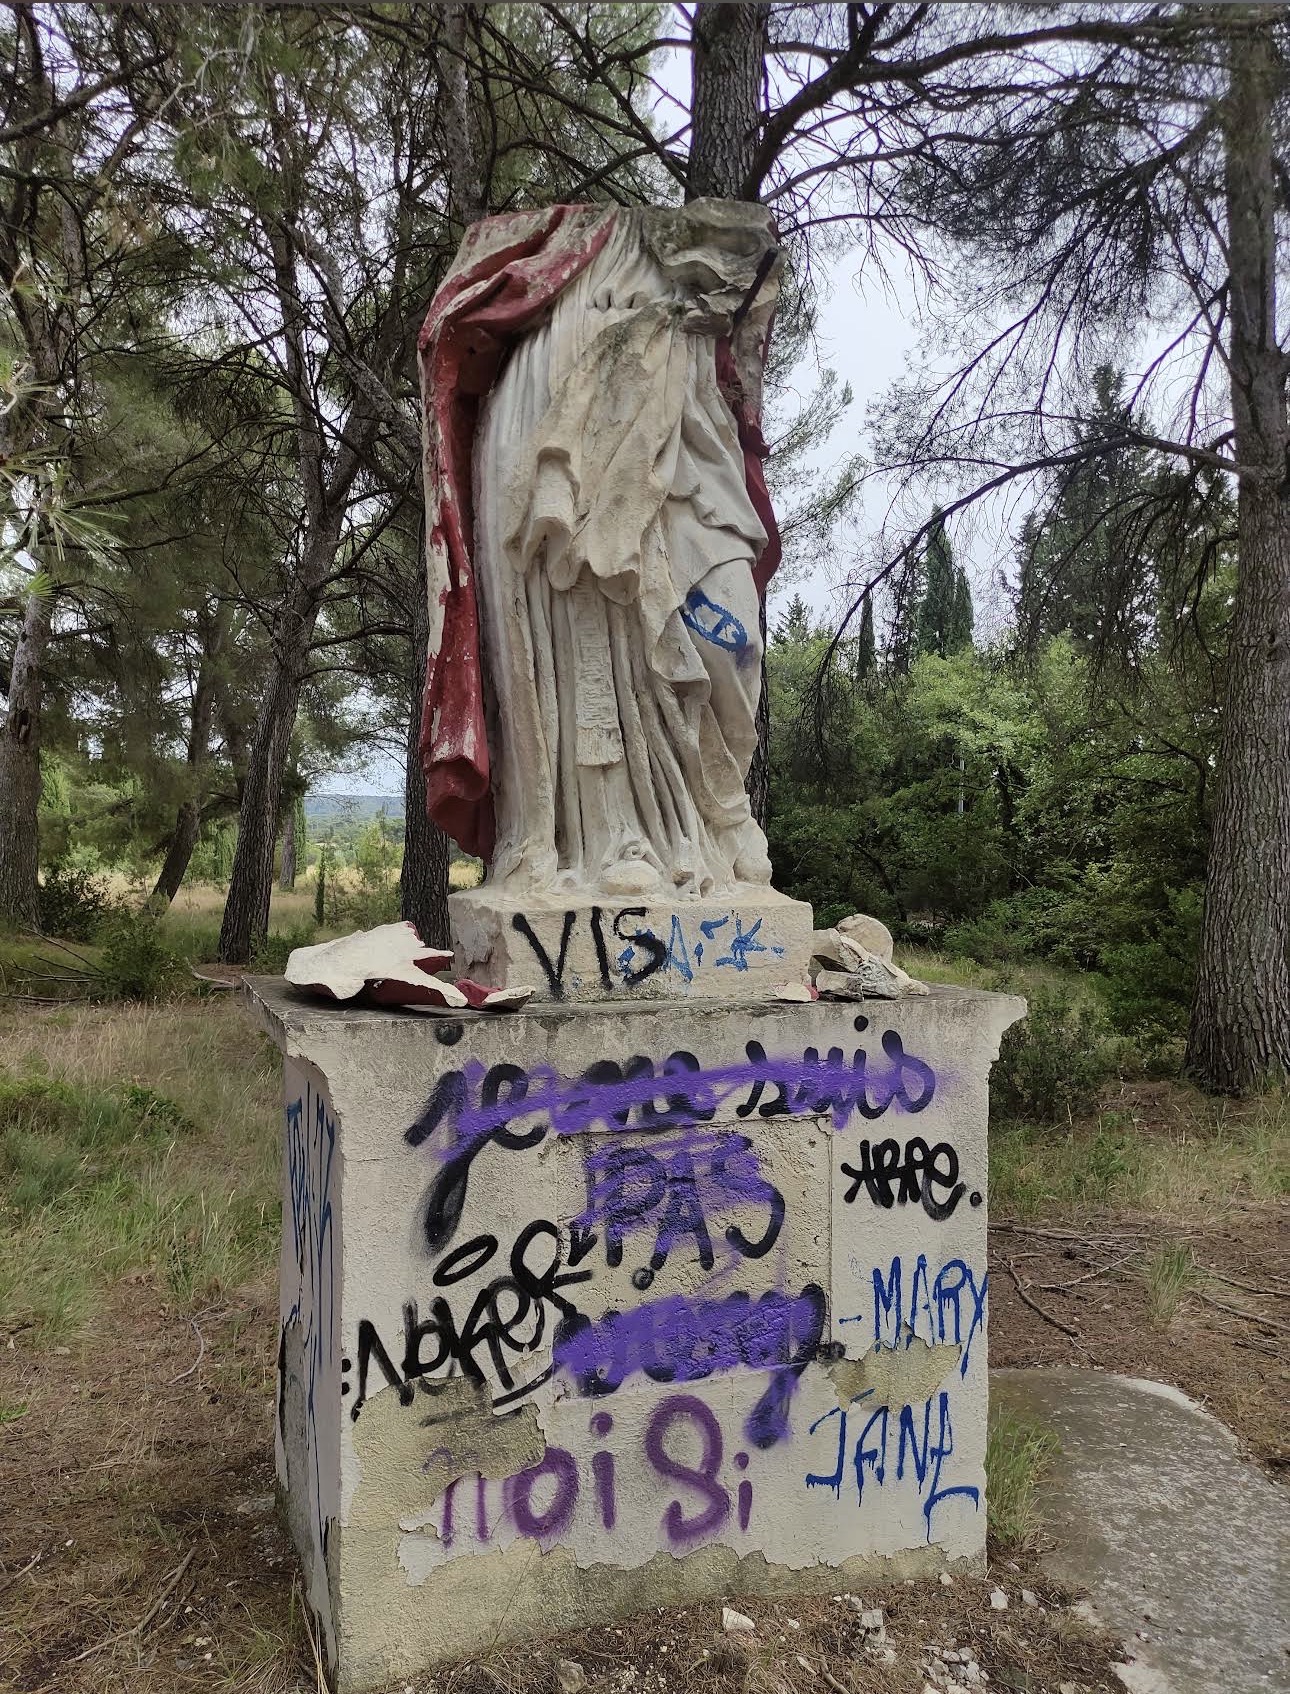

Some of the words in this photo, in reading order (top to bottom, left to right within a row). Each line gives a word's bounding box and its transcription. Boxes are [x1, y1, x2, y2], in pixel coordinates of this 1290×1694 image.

[511, 905, 667, 998] VIS
[736, 1014, 936, 1120] suis
[871, 1253, 988, 1380] MARY
